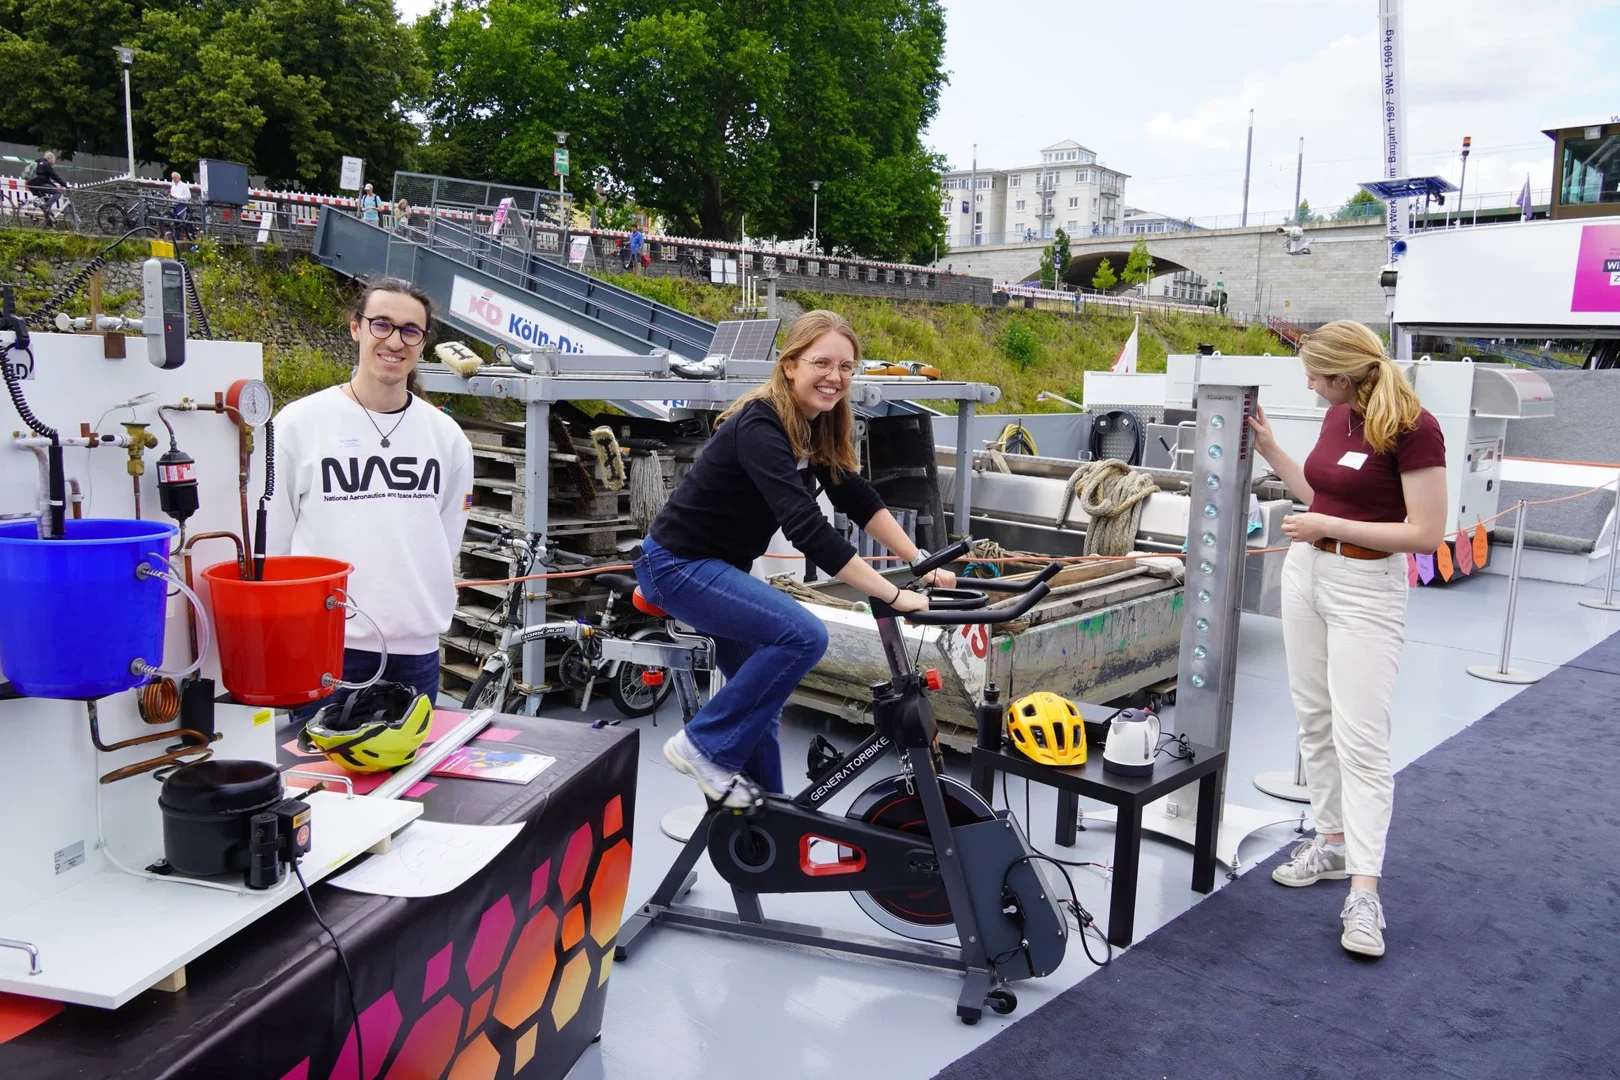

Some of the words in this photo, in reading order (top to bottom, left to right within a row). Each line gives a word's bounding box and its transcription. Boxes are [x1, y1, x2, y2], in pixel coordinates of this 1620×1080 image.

[1383, 29, 1395, 43] kg
[1384, 44, 1393, 69] 1500
[1385, 71, 1395, 95] SWL
[1386, 101, 1395, 123] 1987
[1387, 126, 1398, 163] Baujahr
[469, 294, 503, 326] KD
[321, 455, 441, 495] NASA
[323, 494, 349, 502] National
[810, 736, 890, 801] GENERATORBIKE
